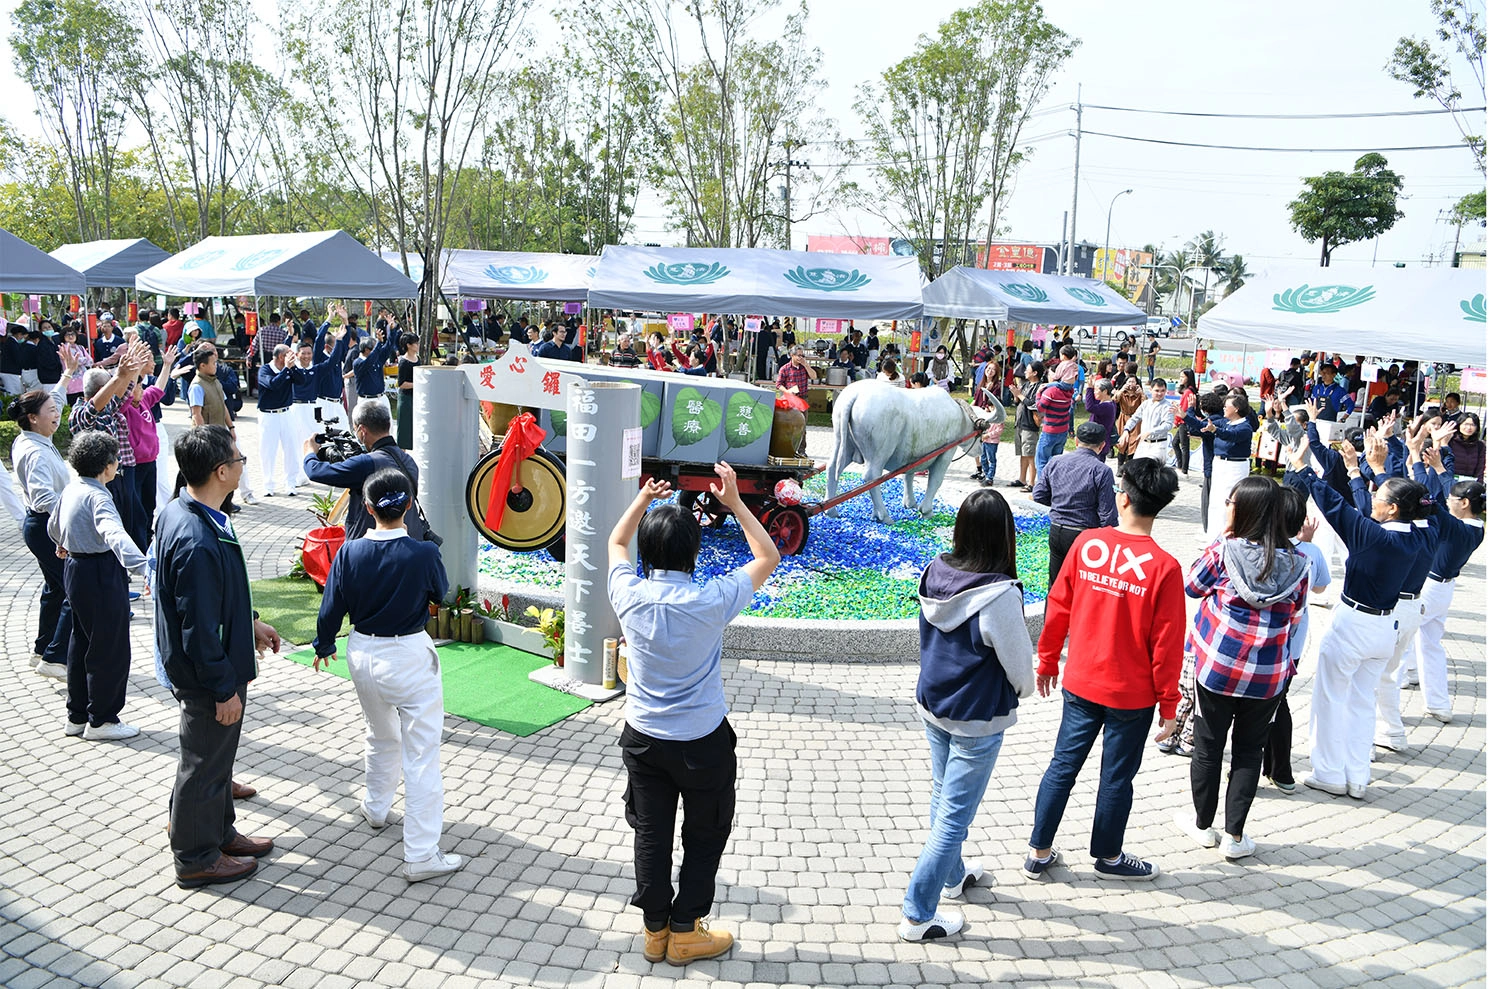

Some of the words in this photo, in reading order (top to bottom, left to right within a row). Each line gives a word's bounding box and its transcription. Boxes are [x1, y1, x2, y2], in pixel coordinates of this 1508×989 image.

[479, 356, 562, 396] 愛心鑼
[683, 400, 704, 434] 醫療
[734, 405, 754, 436] 慈善
[569, 389, 599, 664] 福田一方邀天下善士
[1087, 571, 1119, 588] BELIEVE
[1129, 583, 1147, 597] NOT
